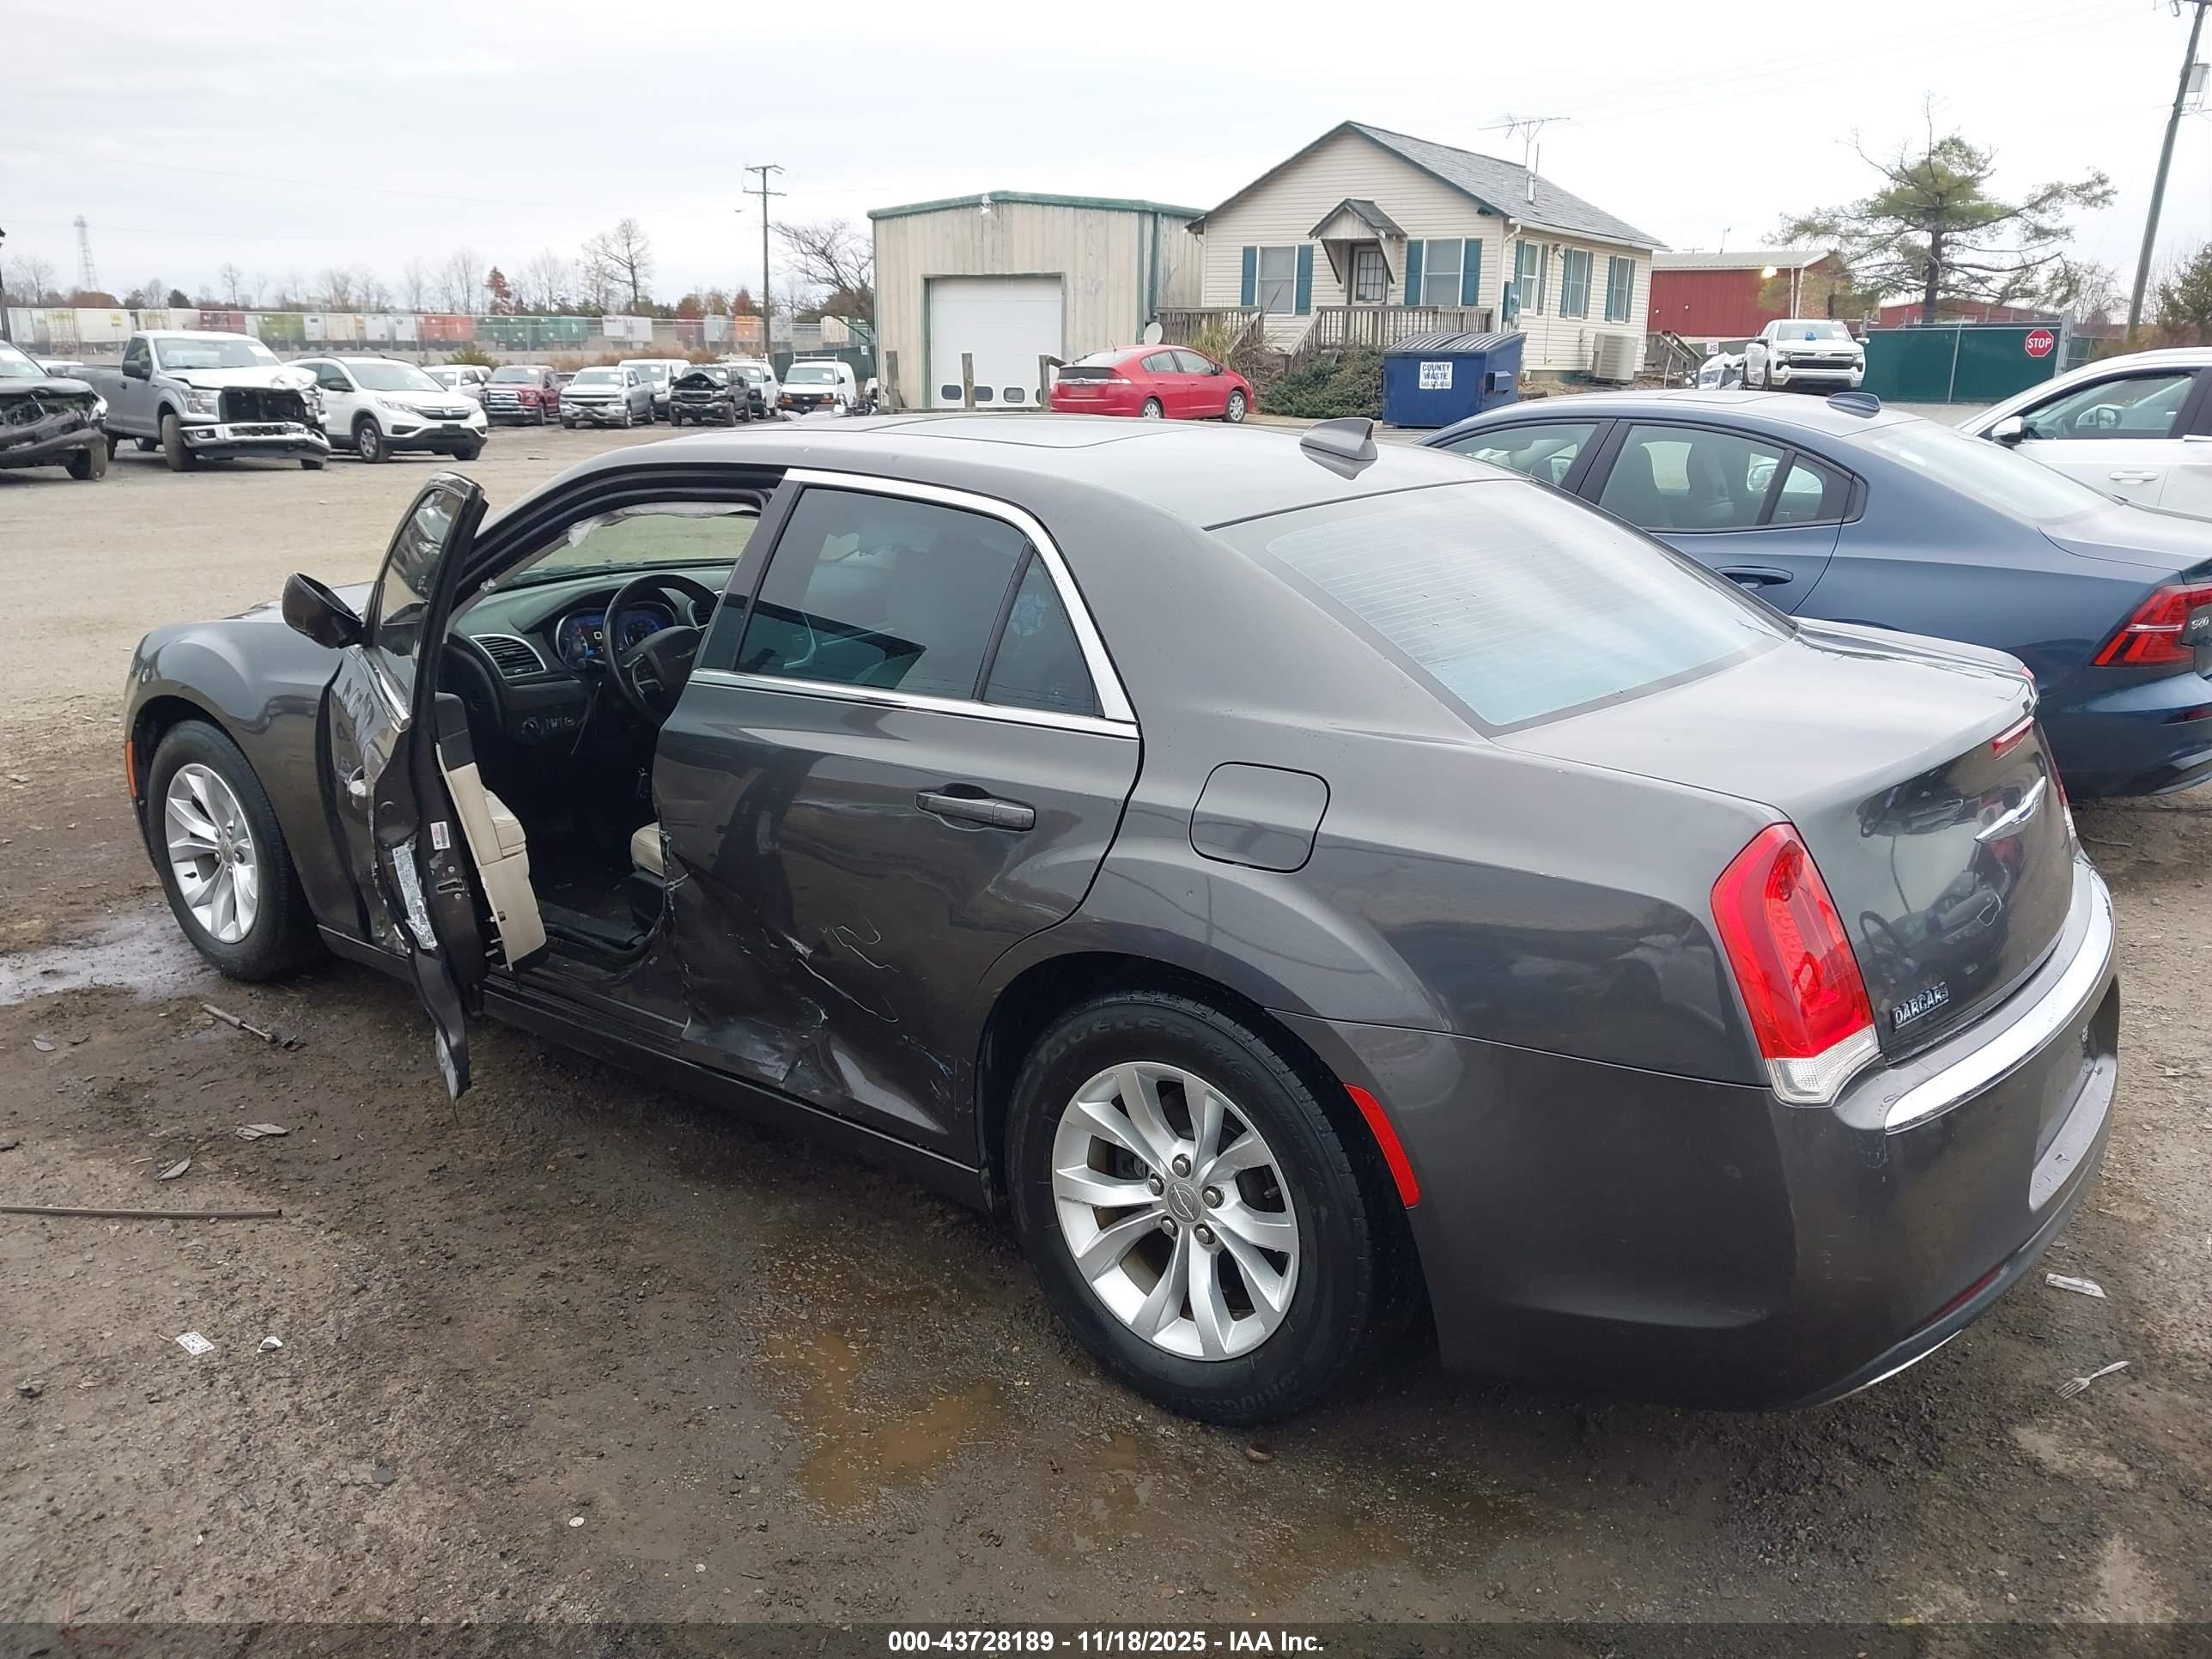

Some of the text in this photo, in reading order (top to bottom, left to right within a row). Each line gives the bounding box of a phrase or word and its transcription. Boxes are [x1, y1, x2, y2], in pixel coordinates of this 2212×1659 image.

[2027, 337, 2052, 349] STOP
[1422, 363, 1451, 372] COUNTY
[1424, 372, 1449, 380] WASTE
[1893, 982, 1949, 1024] DARCARS
